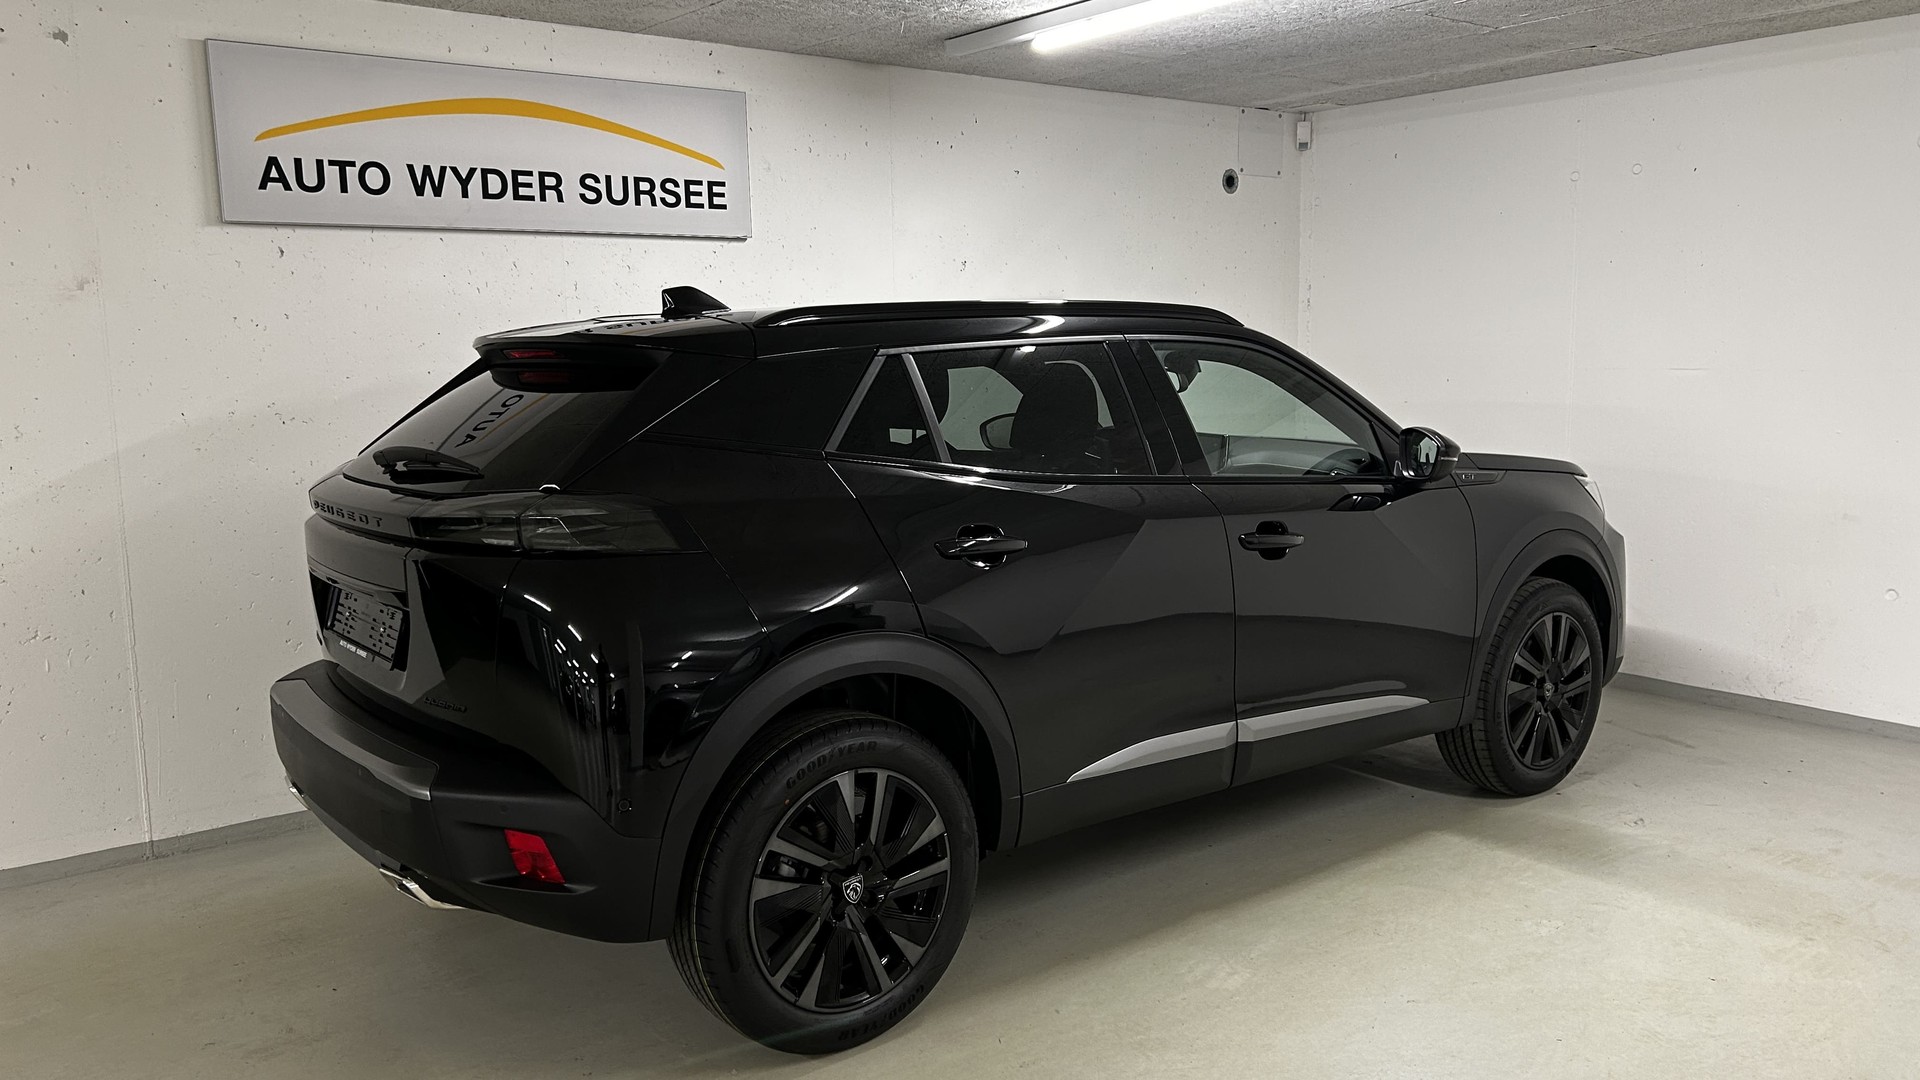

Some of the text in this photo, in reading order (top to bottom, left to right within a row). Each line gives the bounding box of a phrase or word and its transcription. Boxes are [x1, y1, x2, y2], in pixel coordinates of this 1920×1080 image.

[258, 156, 728, 210] AUTO WYDER SURSEE
[313, 499, 383, 527] PEUGEOT
[785, 740, 878, 790] GOODYEAR
